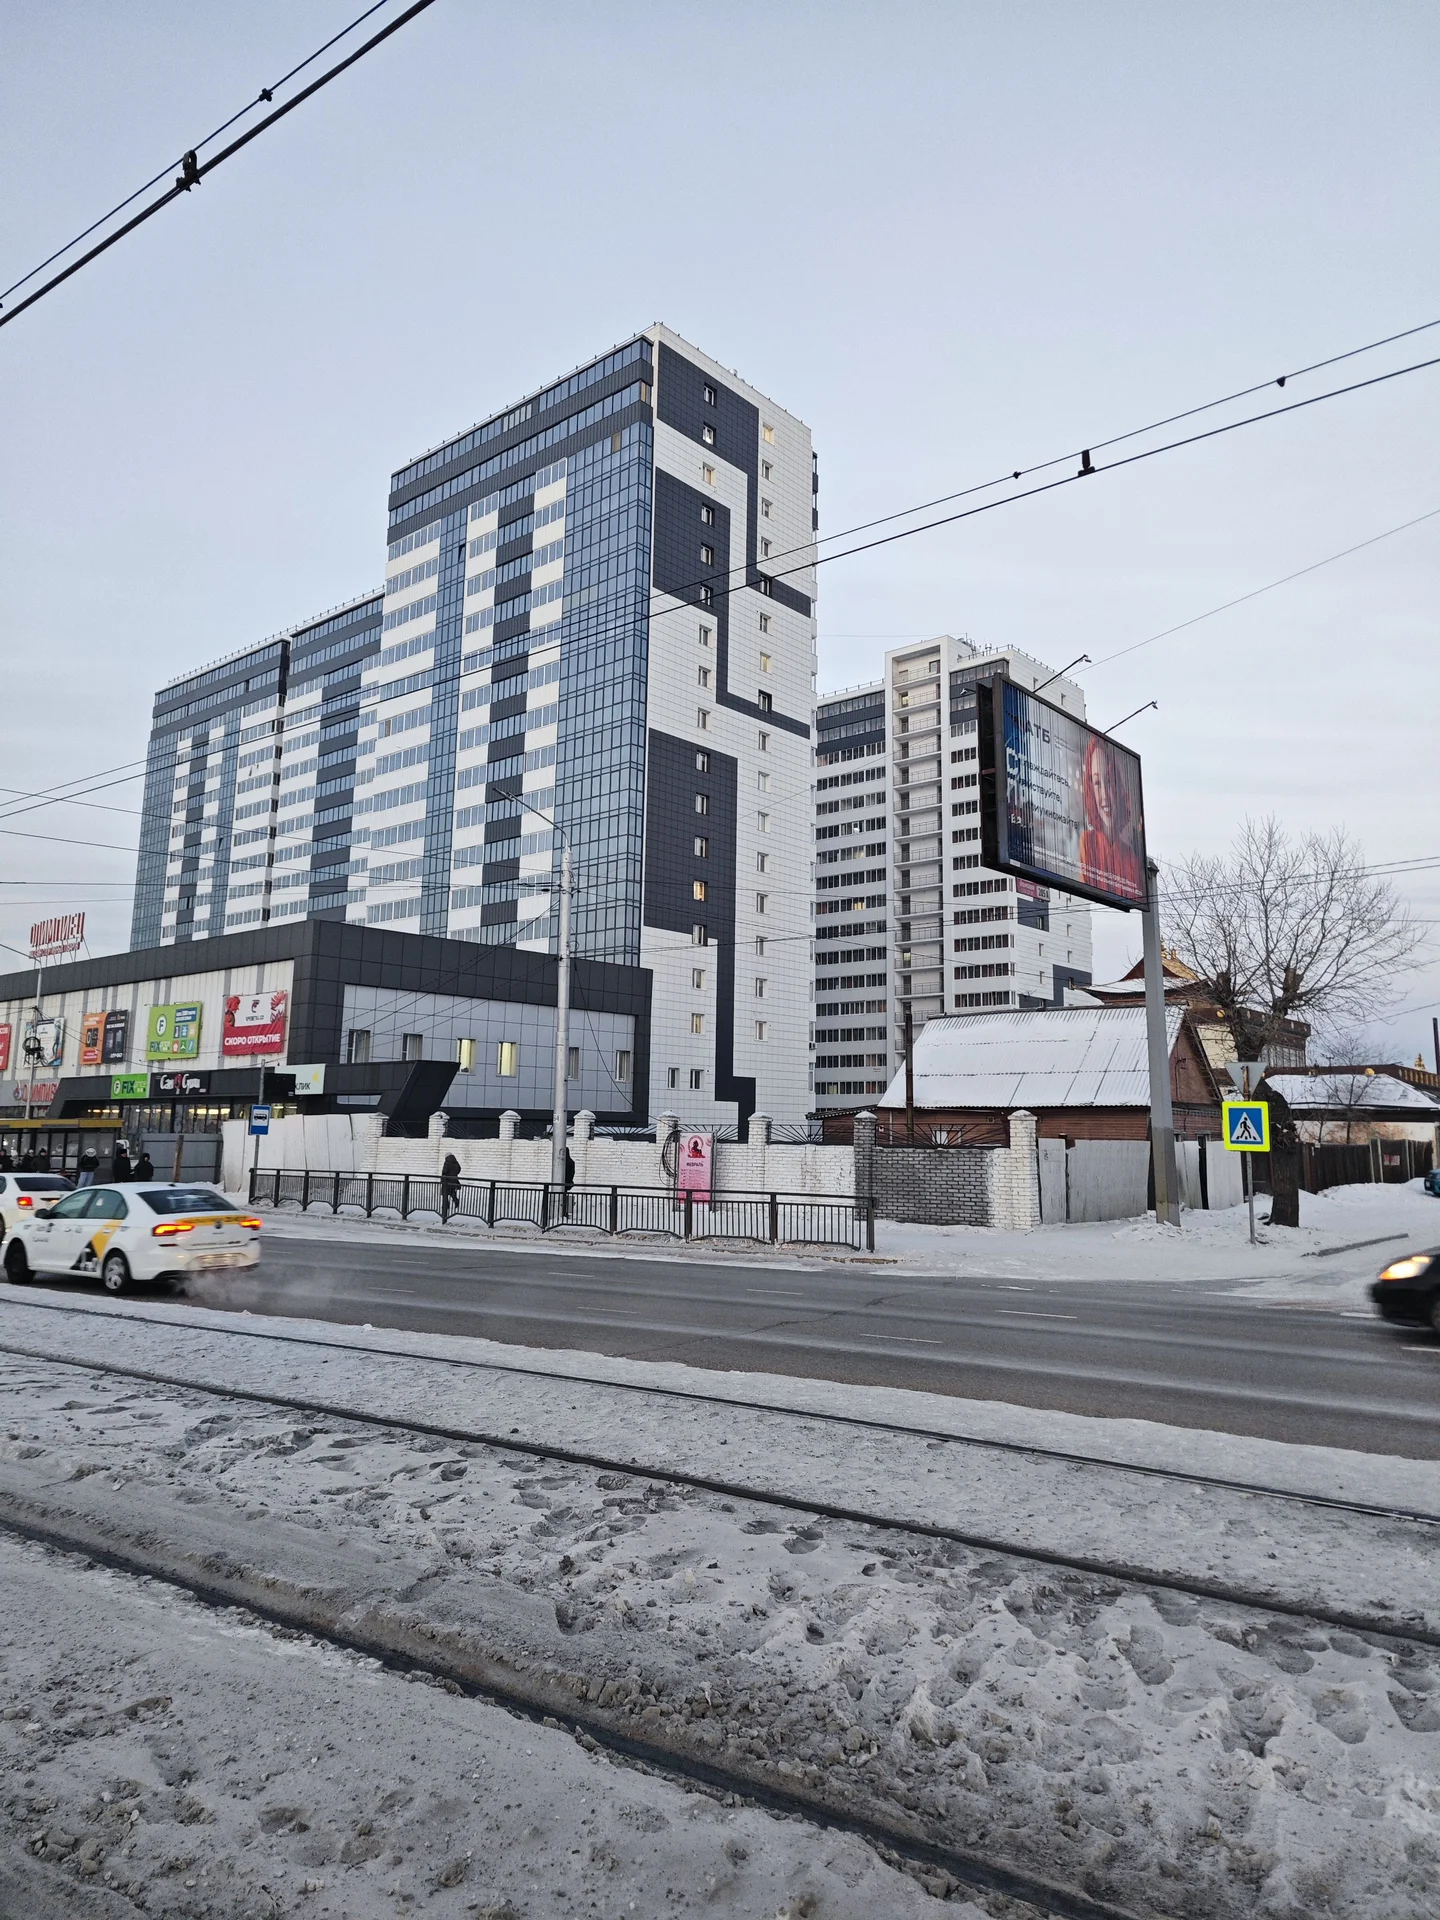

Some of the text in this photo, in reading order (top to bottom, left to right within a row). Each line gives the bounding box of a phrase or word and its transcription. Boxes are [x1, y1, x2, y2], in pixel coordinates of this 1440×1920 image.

[30, 911, 86, 948] ОЛИМПИЕЦ
[224, 1033, 281, 1047] СКОРО ОТКРЫТИЕ
